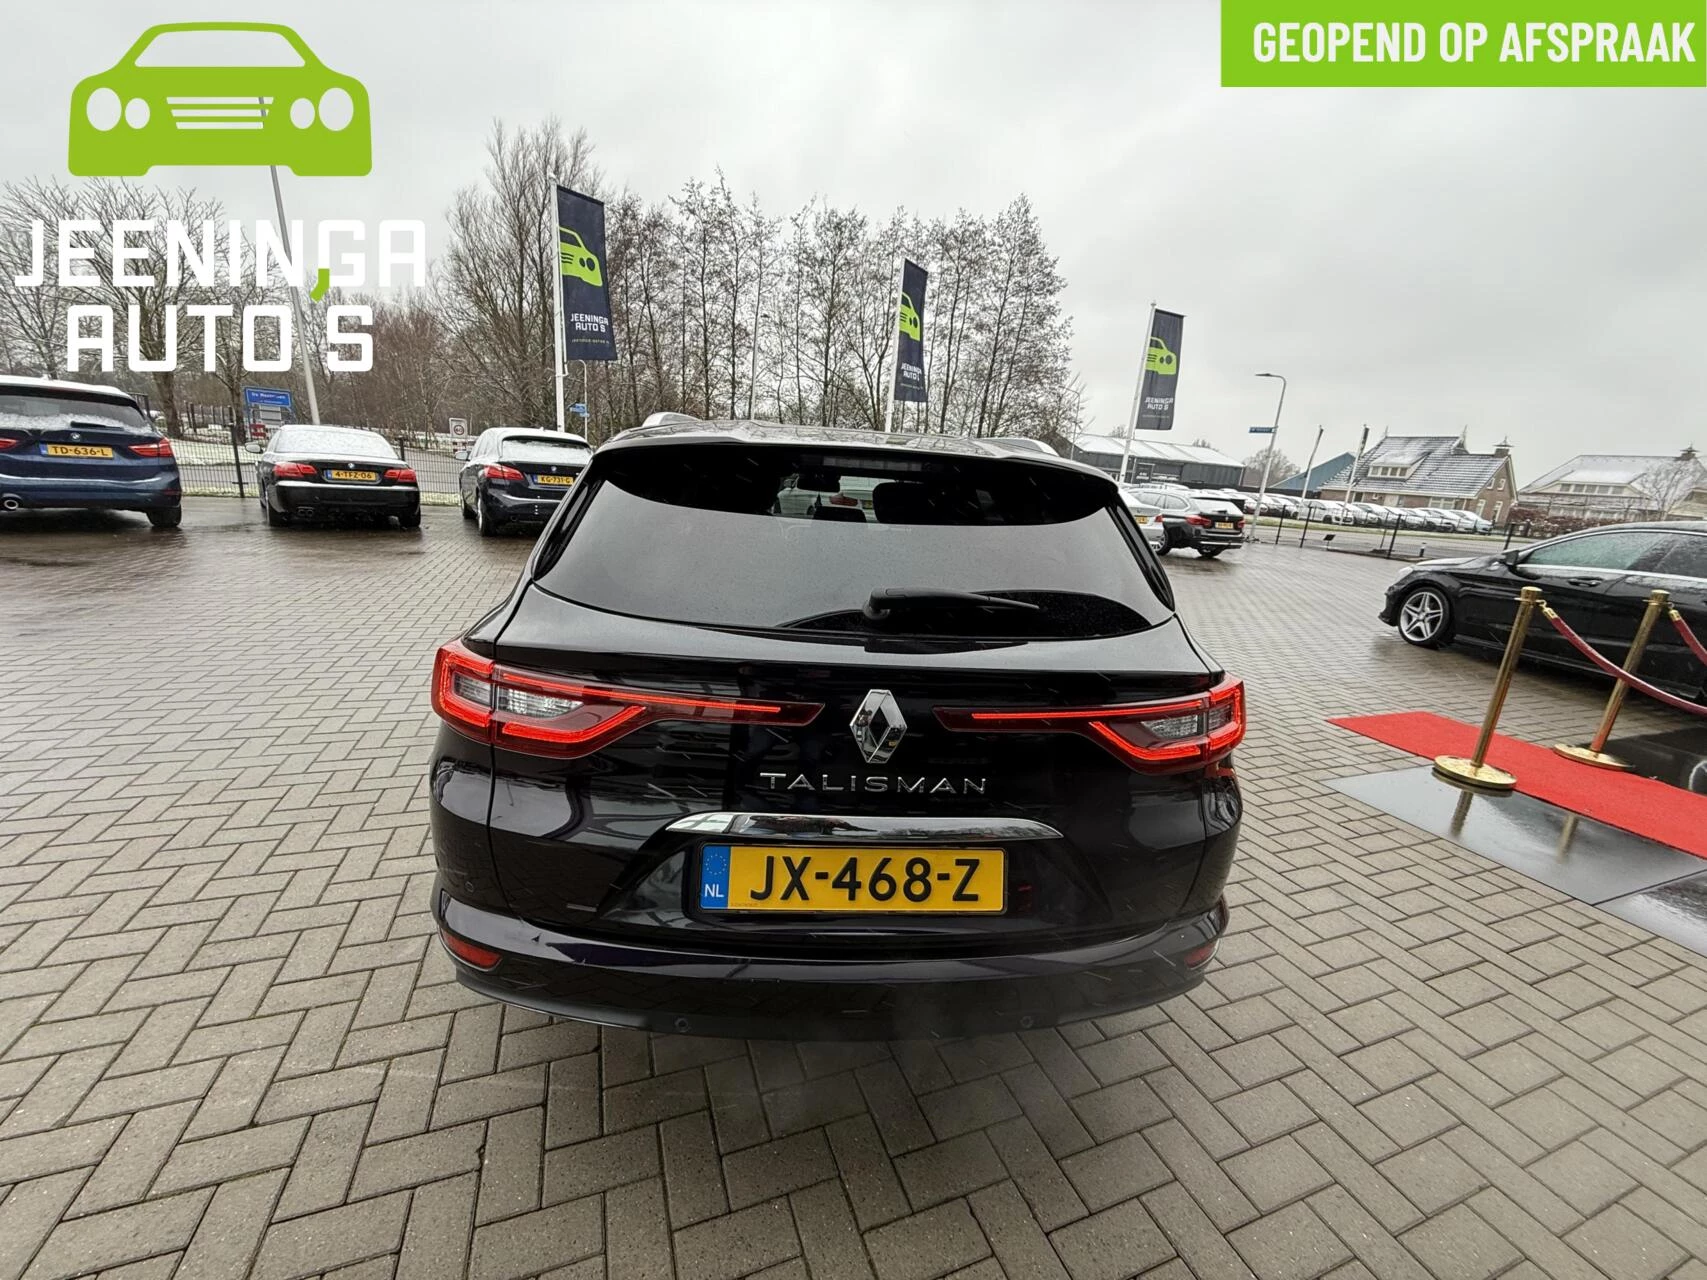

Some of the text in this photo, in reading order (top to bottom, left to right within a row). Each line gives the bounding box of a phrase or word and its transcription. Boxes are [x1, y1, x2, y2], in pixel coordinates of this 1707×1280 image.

[570, 313, 608, 325] JEENINGA
[51, 446, 108, 456] TD-636-L
[335, 471, 372, 479] 4-TFZ-06
[759, 772, 986, 795] TALISMAN
[750, 855, 980, 902] JX-468-Z
[704, 884, 725, 898] NL
